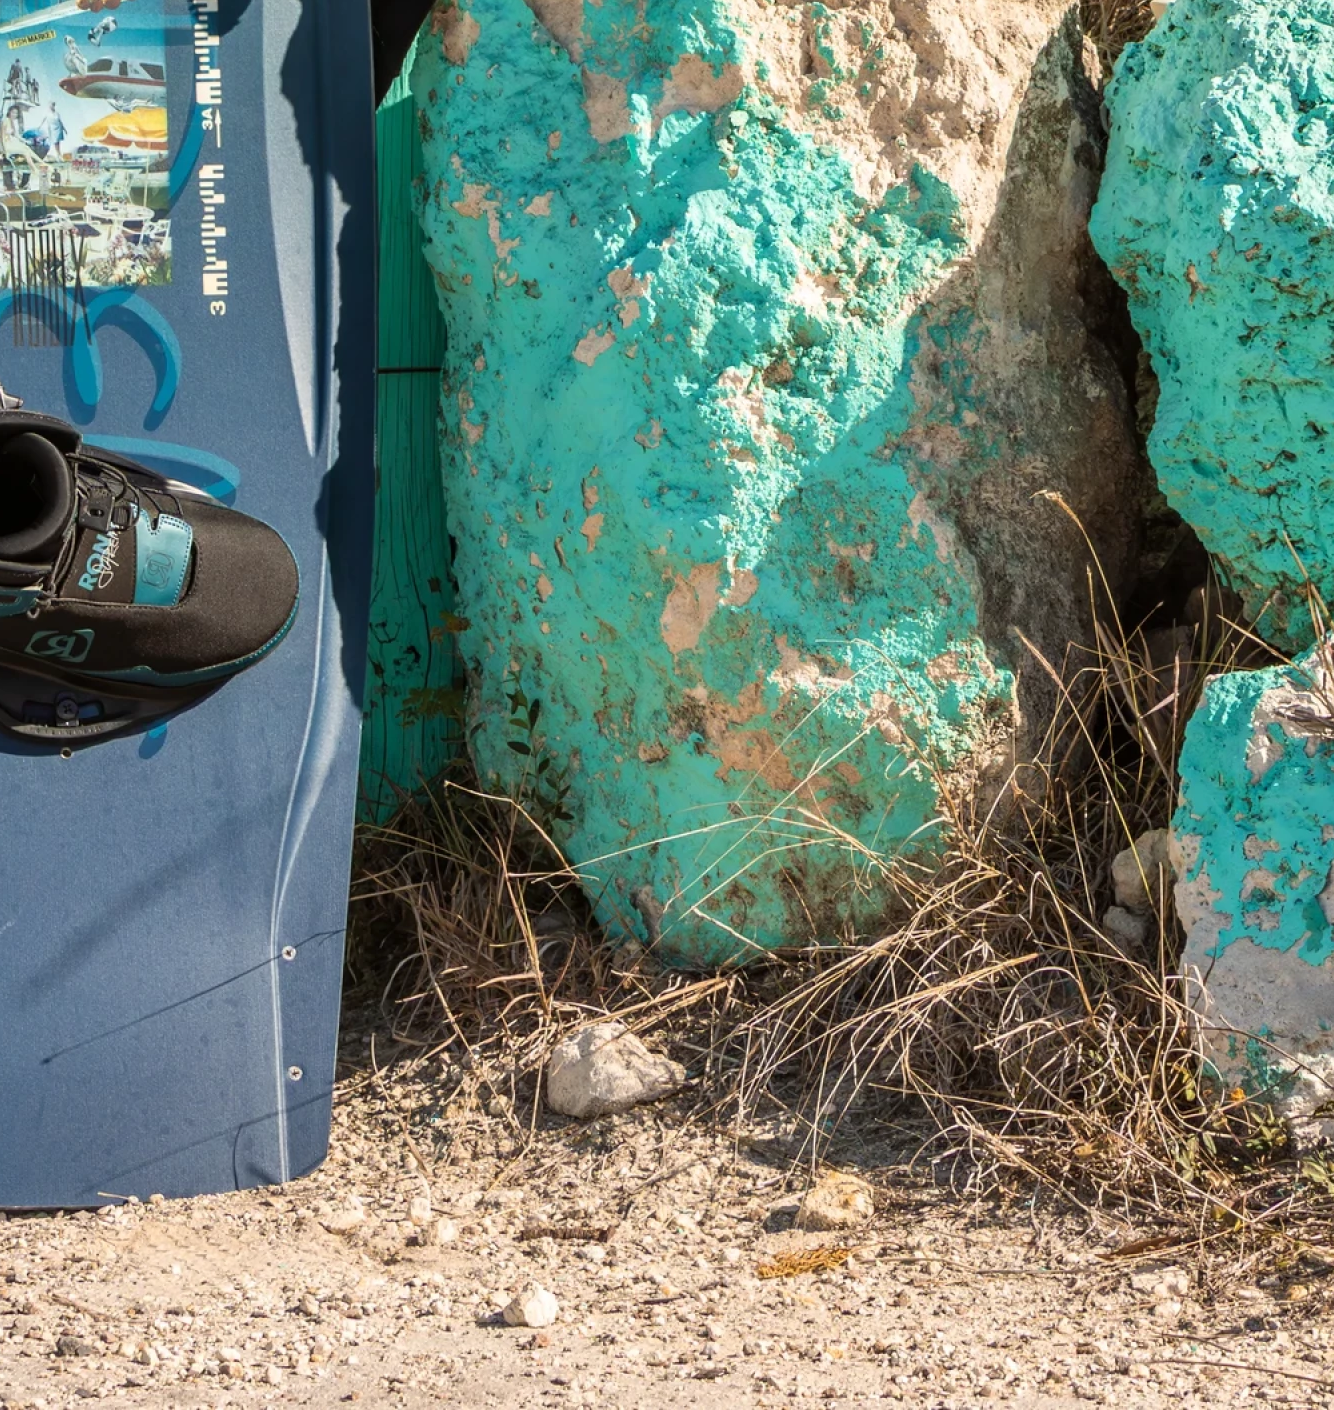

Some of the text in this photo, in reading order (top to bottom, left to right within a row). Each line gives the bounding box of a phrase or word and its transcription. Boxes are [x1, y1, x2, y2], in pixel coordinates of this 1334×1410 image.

[201, 107, 213, 130] 3A
[210, 300, 227, 316] 3
[78, 532, 111, 591] RON
